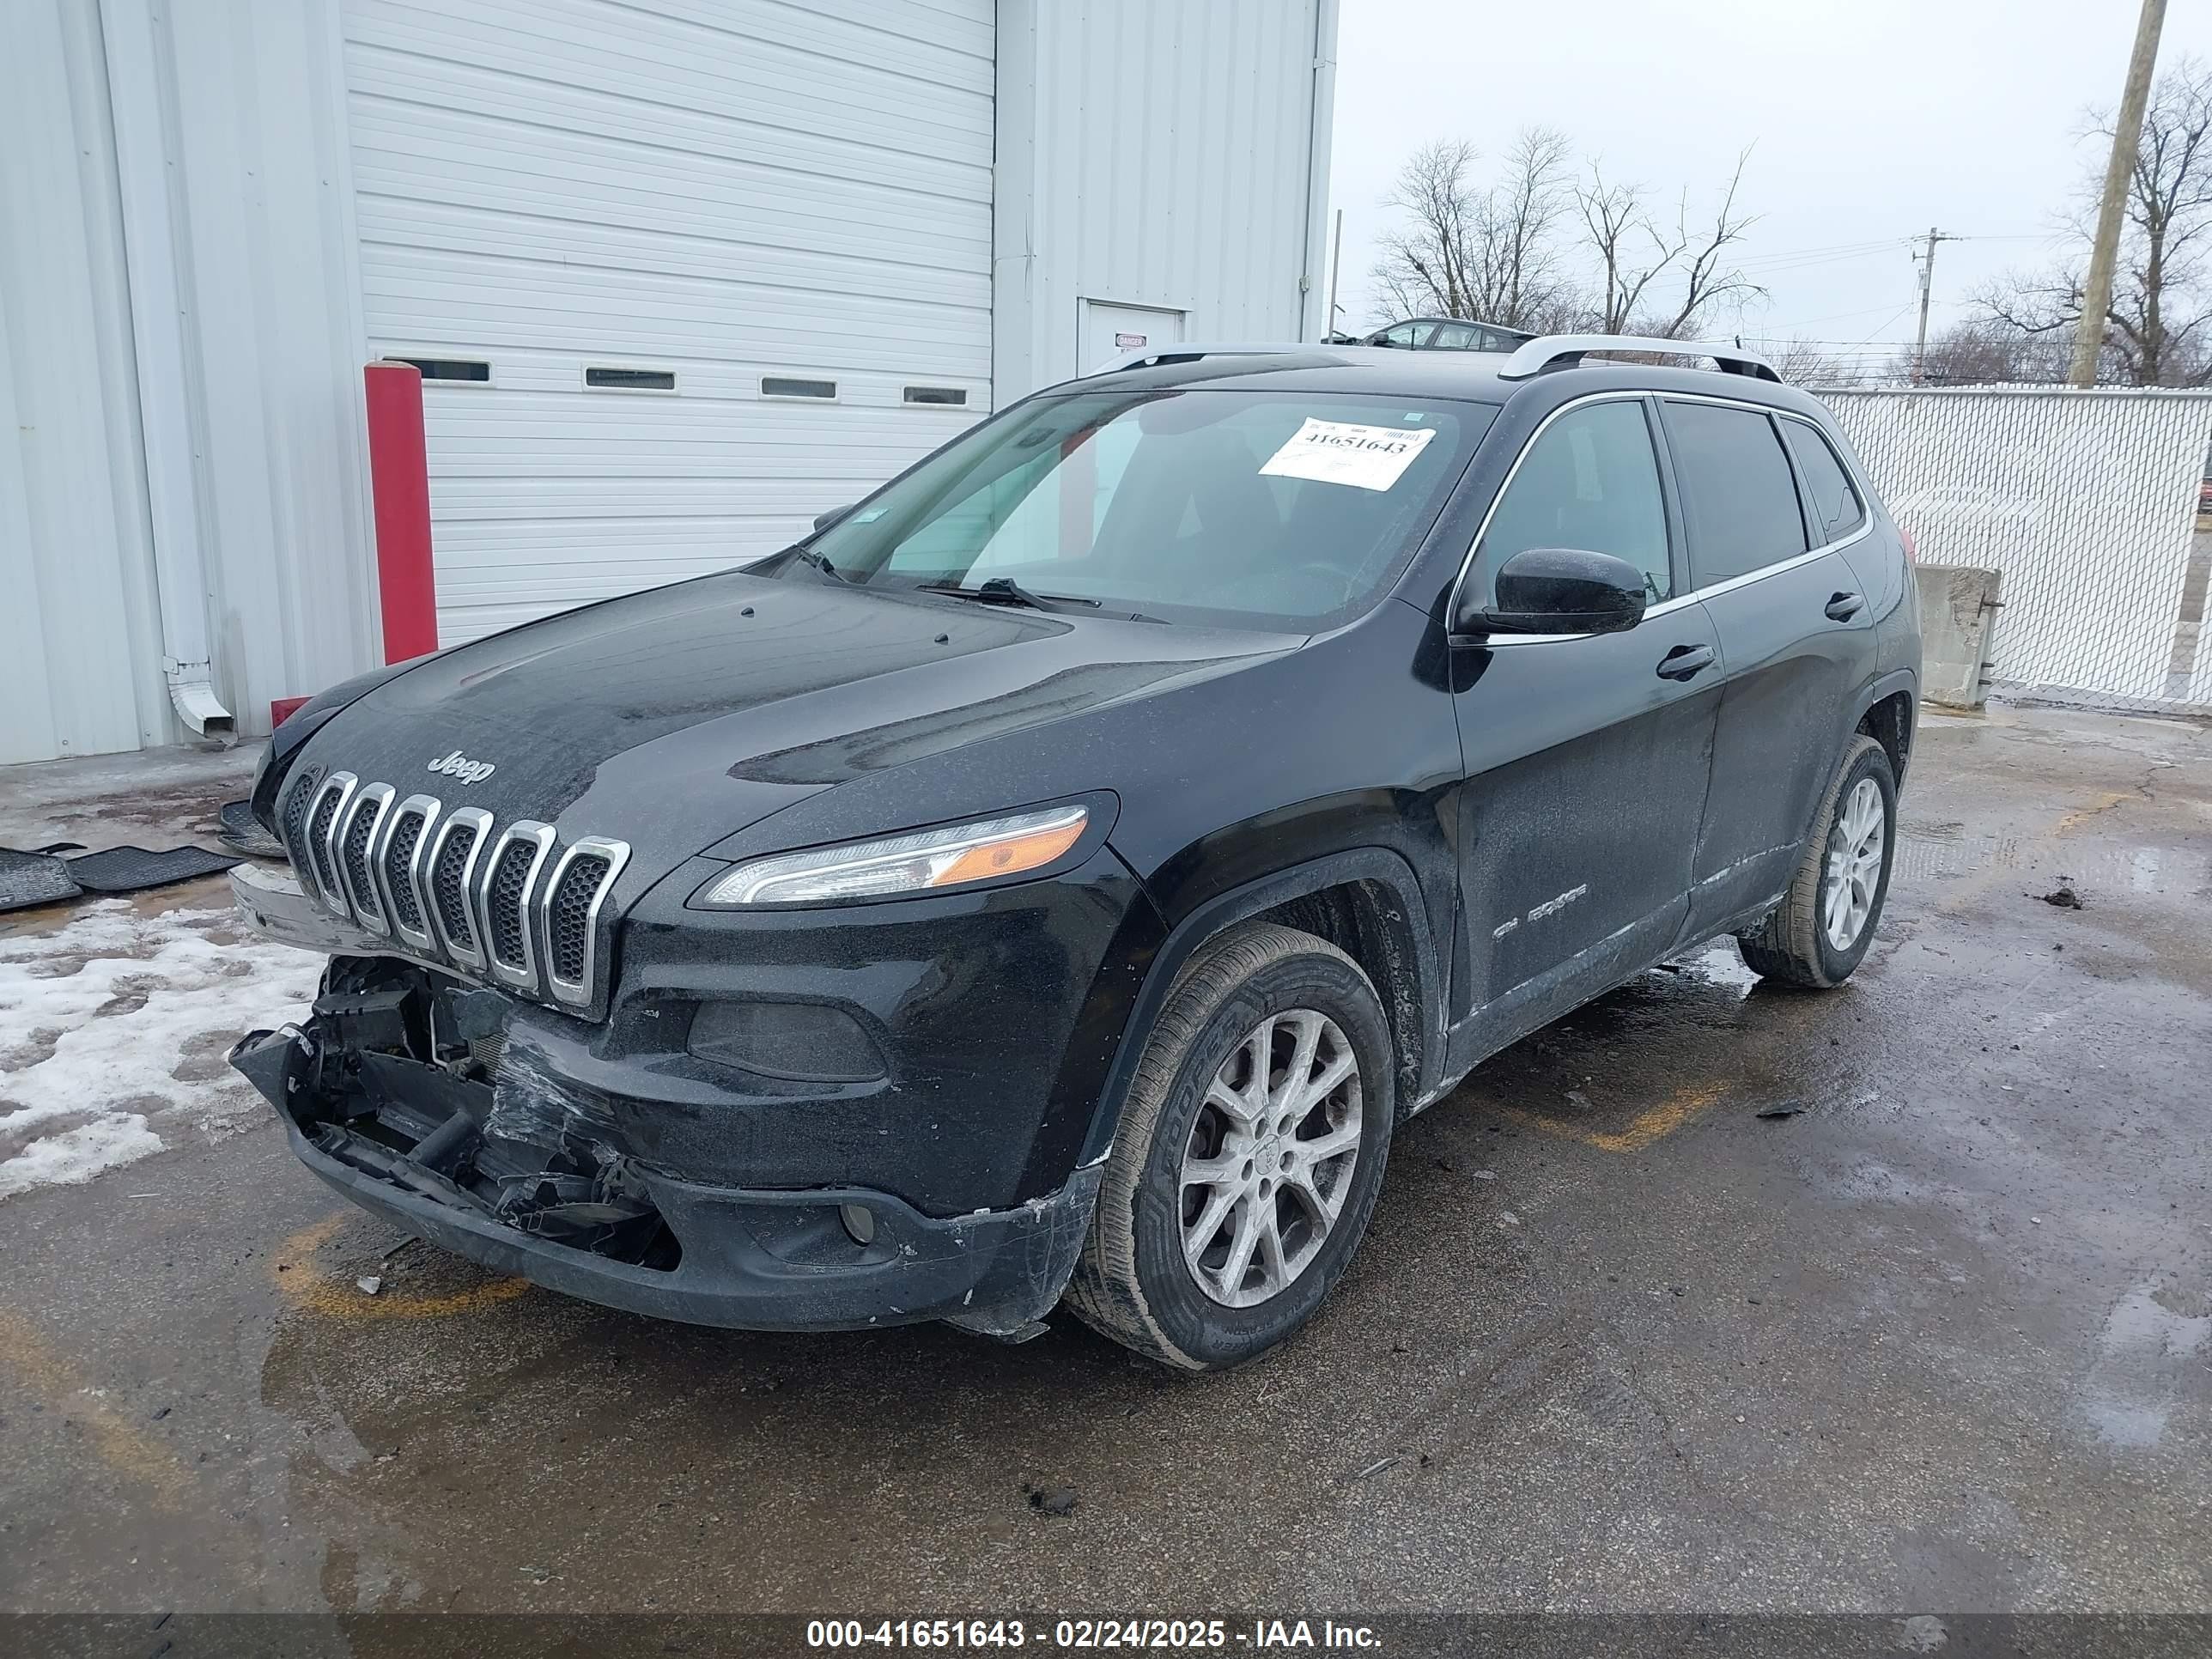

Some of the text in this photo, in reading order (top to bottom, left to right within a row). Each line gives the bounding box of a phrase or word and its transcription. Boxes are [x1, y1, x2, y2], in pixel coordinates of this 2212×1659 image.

[1120, 336, 1143, 346] DANGER
[1305, 433, 1407, 454] 41651643
[428, 750, 495, 786] Jeep
